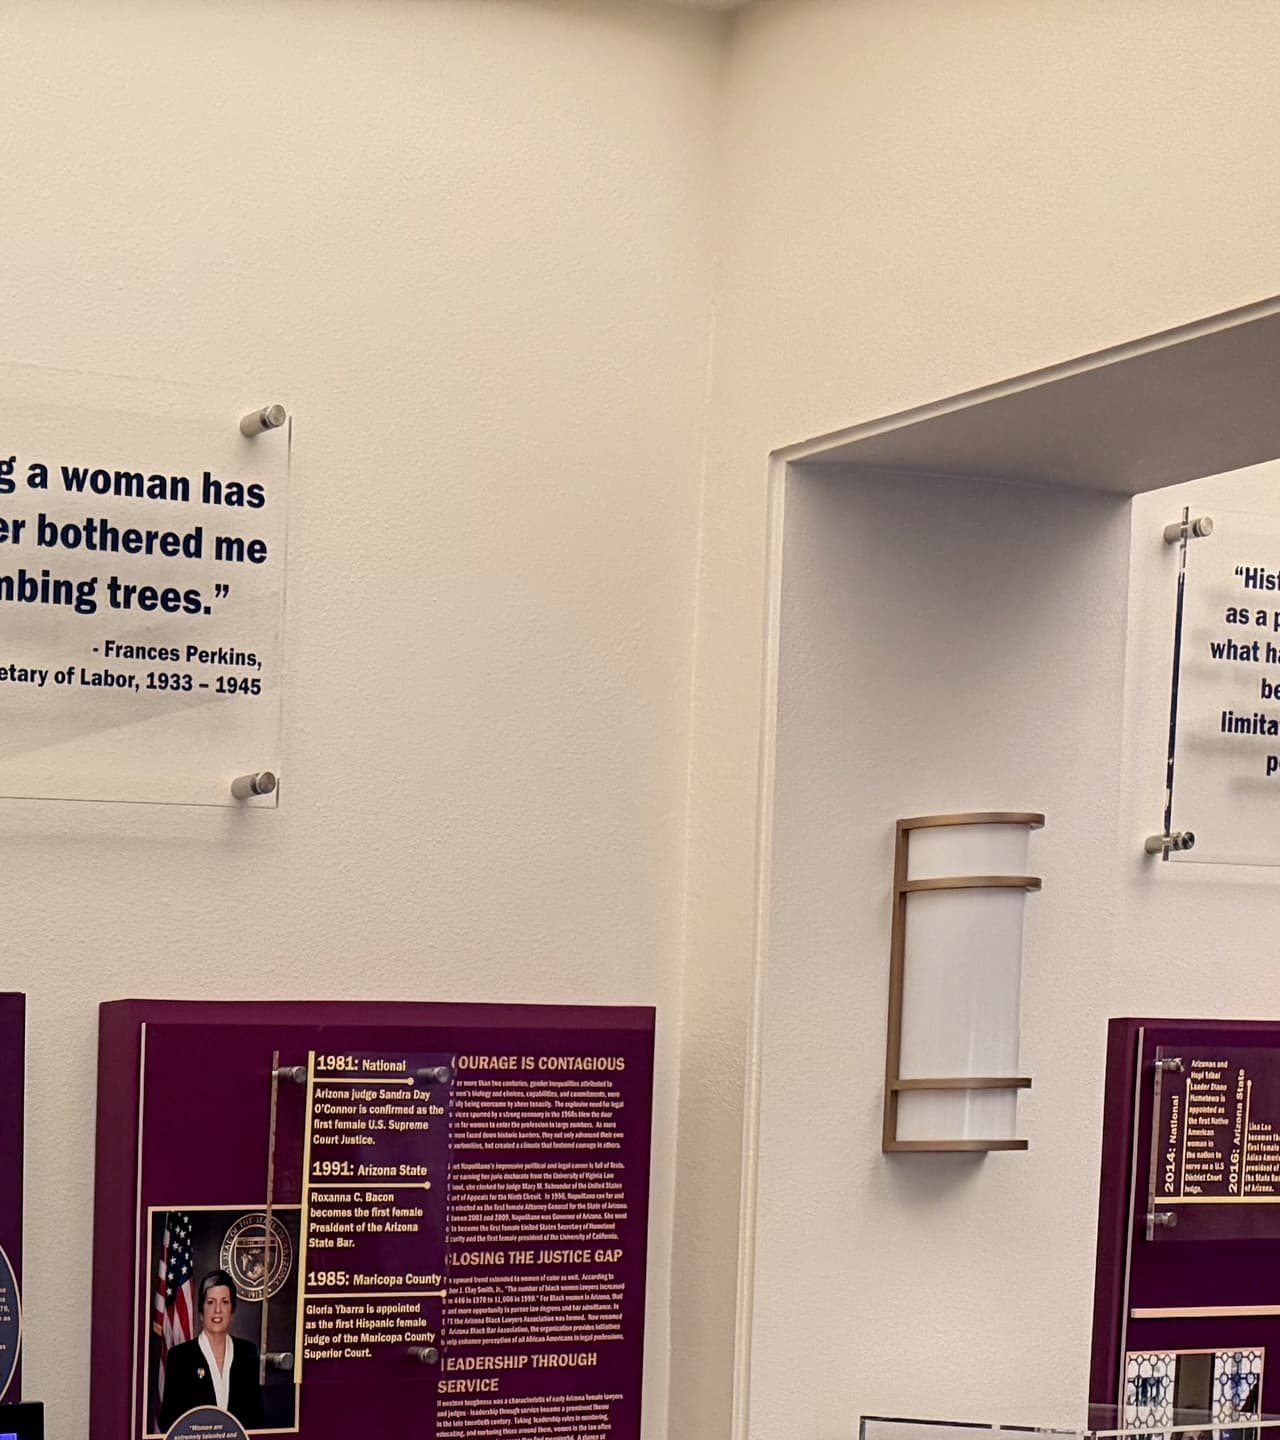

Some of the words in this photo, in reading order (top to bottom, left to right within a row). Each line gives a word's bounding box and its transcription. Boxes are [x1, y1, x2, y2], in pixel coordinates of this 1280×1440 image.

[26, 463, 48, 489] a
[60, 466, 189, 502] woman
[202, 471, 265, 509] has
[37, 512, 202, 559] bothered
[215, 536, 267, 564] me
[106, 575, 229, 615] trees.”
[1225, 606, 1250, 625] as
[1255, 609, 1268, 627] a
[104, 639, 180, 662] Frances
[186, 644, 261, 671] Perkins,
[1210, 638, 1260, 662] what
[54, 666, 75, 685] of
[80, 667, 139, 693] Labor,
[146, 671, 192, 692] 1933
[215, 675, 261, 695] 1945
[317, 1055, 358, 1071] 1981:
[362, 1059, 406, 1071] National
[521, 1055, 535, 1070] IS
[538, 1056, 626, 1071] CONTAGIOUS
[1169, 1095, 1179, 1144] National
[312, 1160, 354, 1176] 1991:
[357, 1163, 397, 1176] Arizona
[399, 1164, 427, 1176] State
[1164, 1147, 1177, 1193] 2014:
[1228, 1149, 1240, 1193] 2016:
[508, 1251, 535, 1264] THE
[537, 1250, 591, 1264] JUSTICE
[594, 1249, 623, 1263] GAP
[307, 1271, 349, 1286] 1985:
[353, 1273, 403, 1287] Maricopa
[405, 1273, 441, 1286] County
[531, 1352, 597, 1368] THROUGH
[437, 1378, 499, 1394] SERVICE
